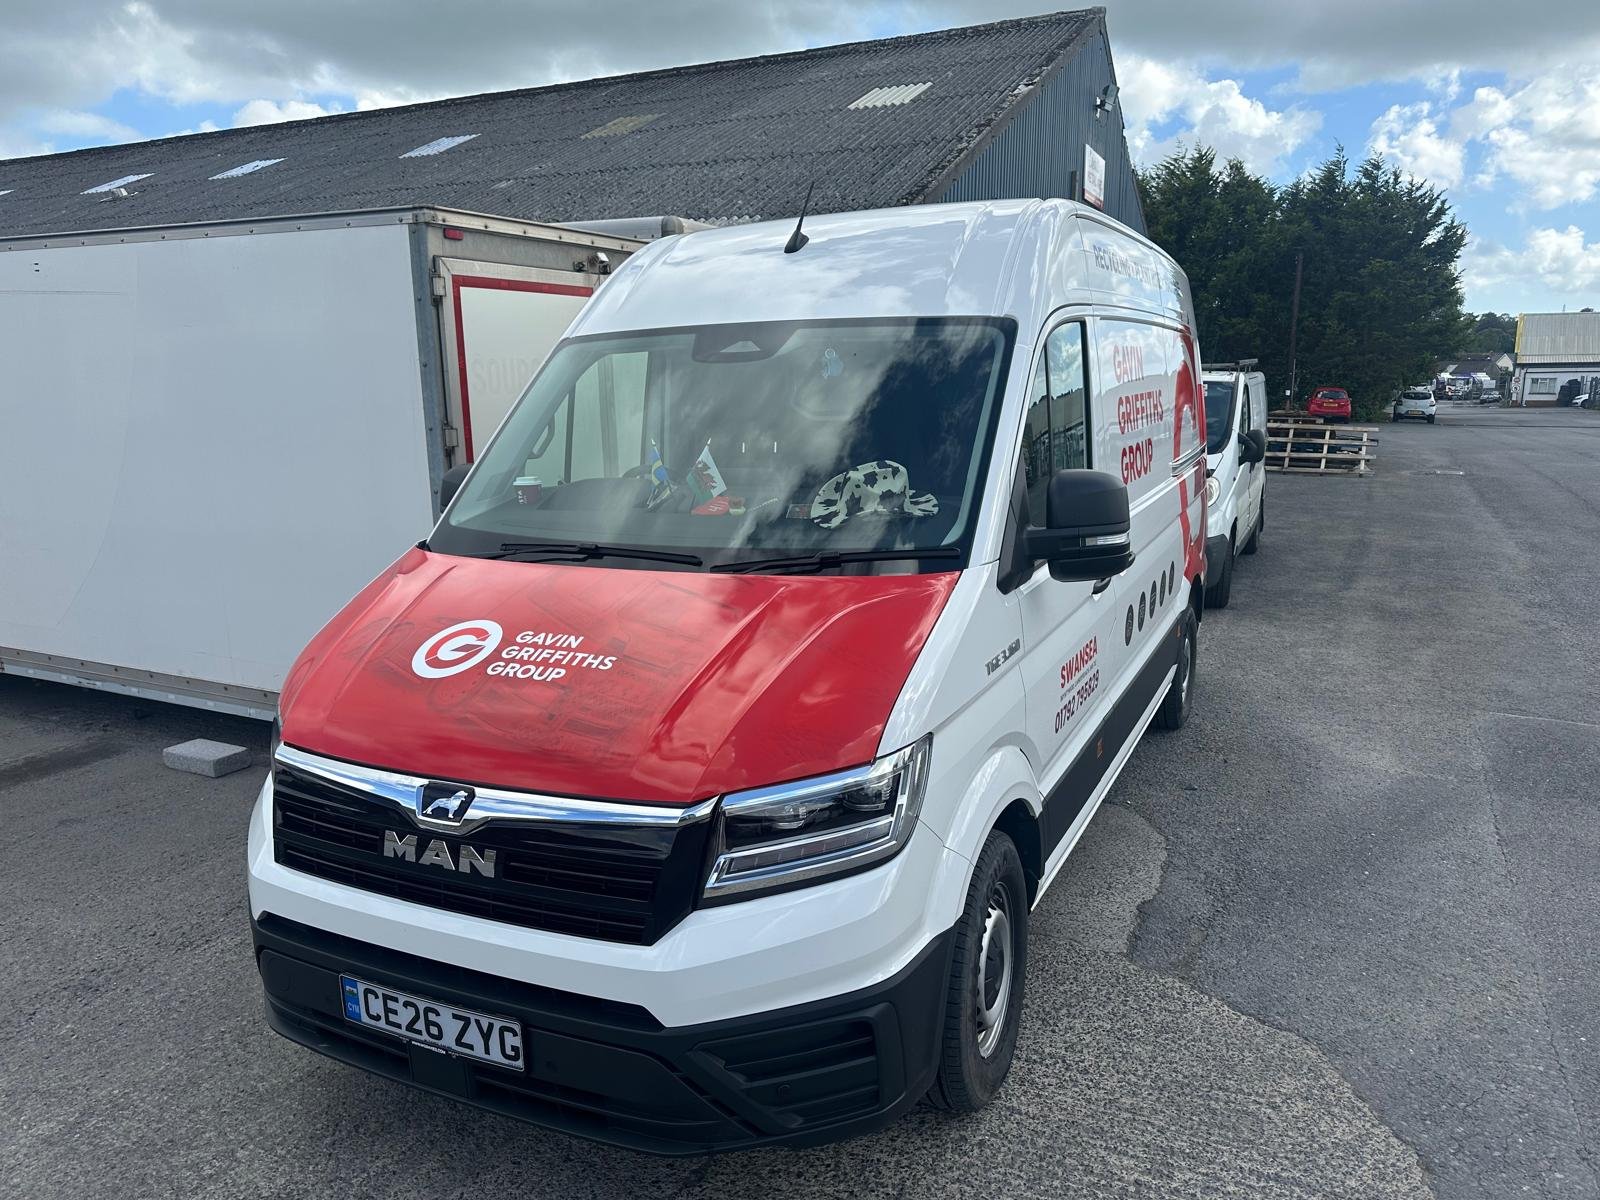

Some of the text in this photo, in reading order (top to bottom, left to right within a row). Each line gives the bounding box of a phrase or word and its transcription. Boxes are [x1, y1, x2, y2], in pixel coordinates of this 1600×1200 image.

[1112, 344, 1144, 383] GAVIN
[1117, 389, 1164, 435] GRIFFITHS
[1121, 438, 1153, 485] GROUP
[501, 645, 618, 671] GRIFFITHS
[515, 630, 584, 649] GAVIN
[486, 661, 567, 682] GROUP
[1061, 636, 1098, 688] SWANSEA
[1055, 695, 1076, 734] 01792
[383, 830, 496, 878] MAN
[363, 987, 521, 1062] CE26 ZYG
